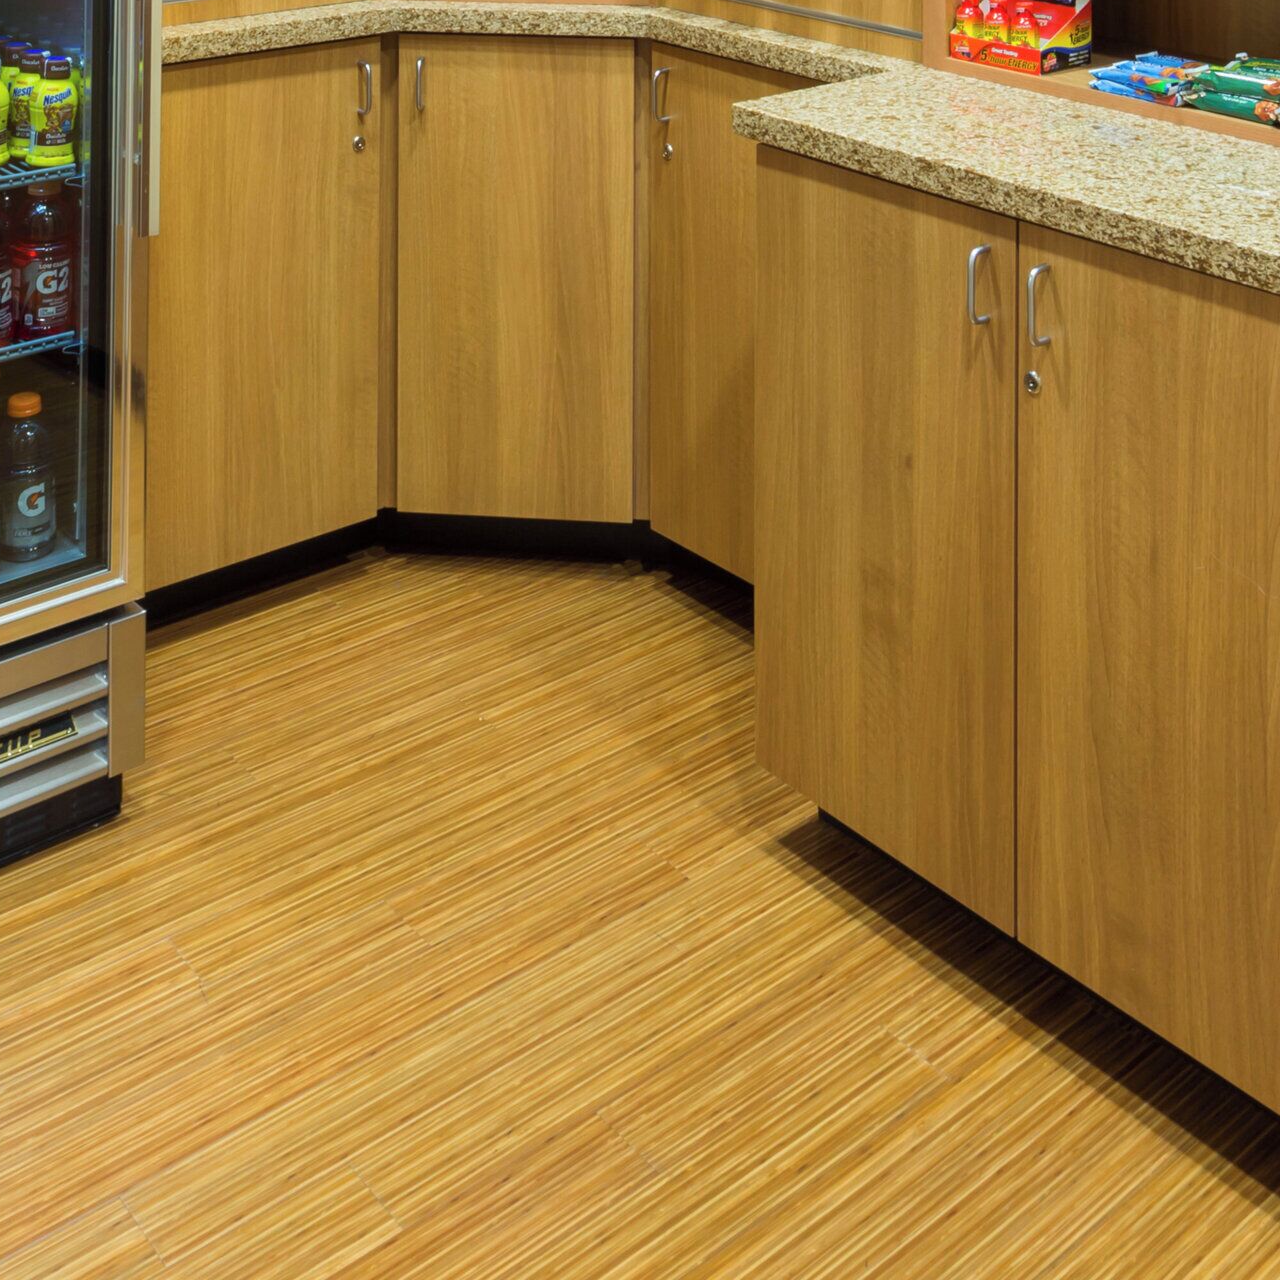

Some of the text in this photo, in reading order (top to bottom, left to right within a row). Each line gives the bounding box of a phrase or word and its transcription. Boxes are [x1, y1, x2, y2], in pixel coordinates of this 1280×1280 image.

[980, 48, 1038, 71] 5-hour ENERGY
[42, 88, 73, 107] Nesquik
[35, 265, 70, 295] G2
[17, 483, 45, 518] G
